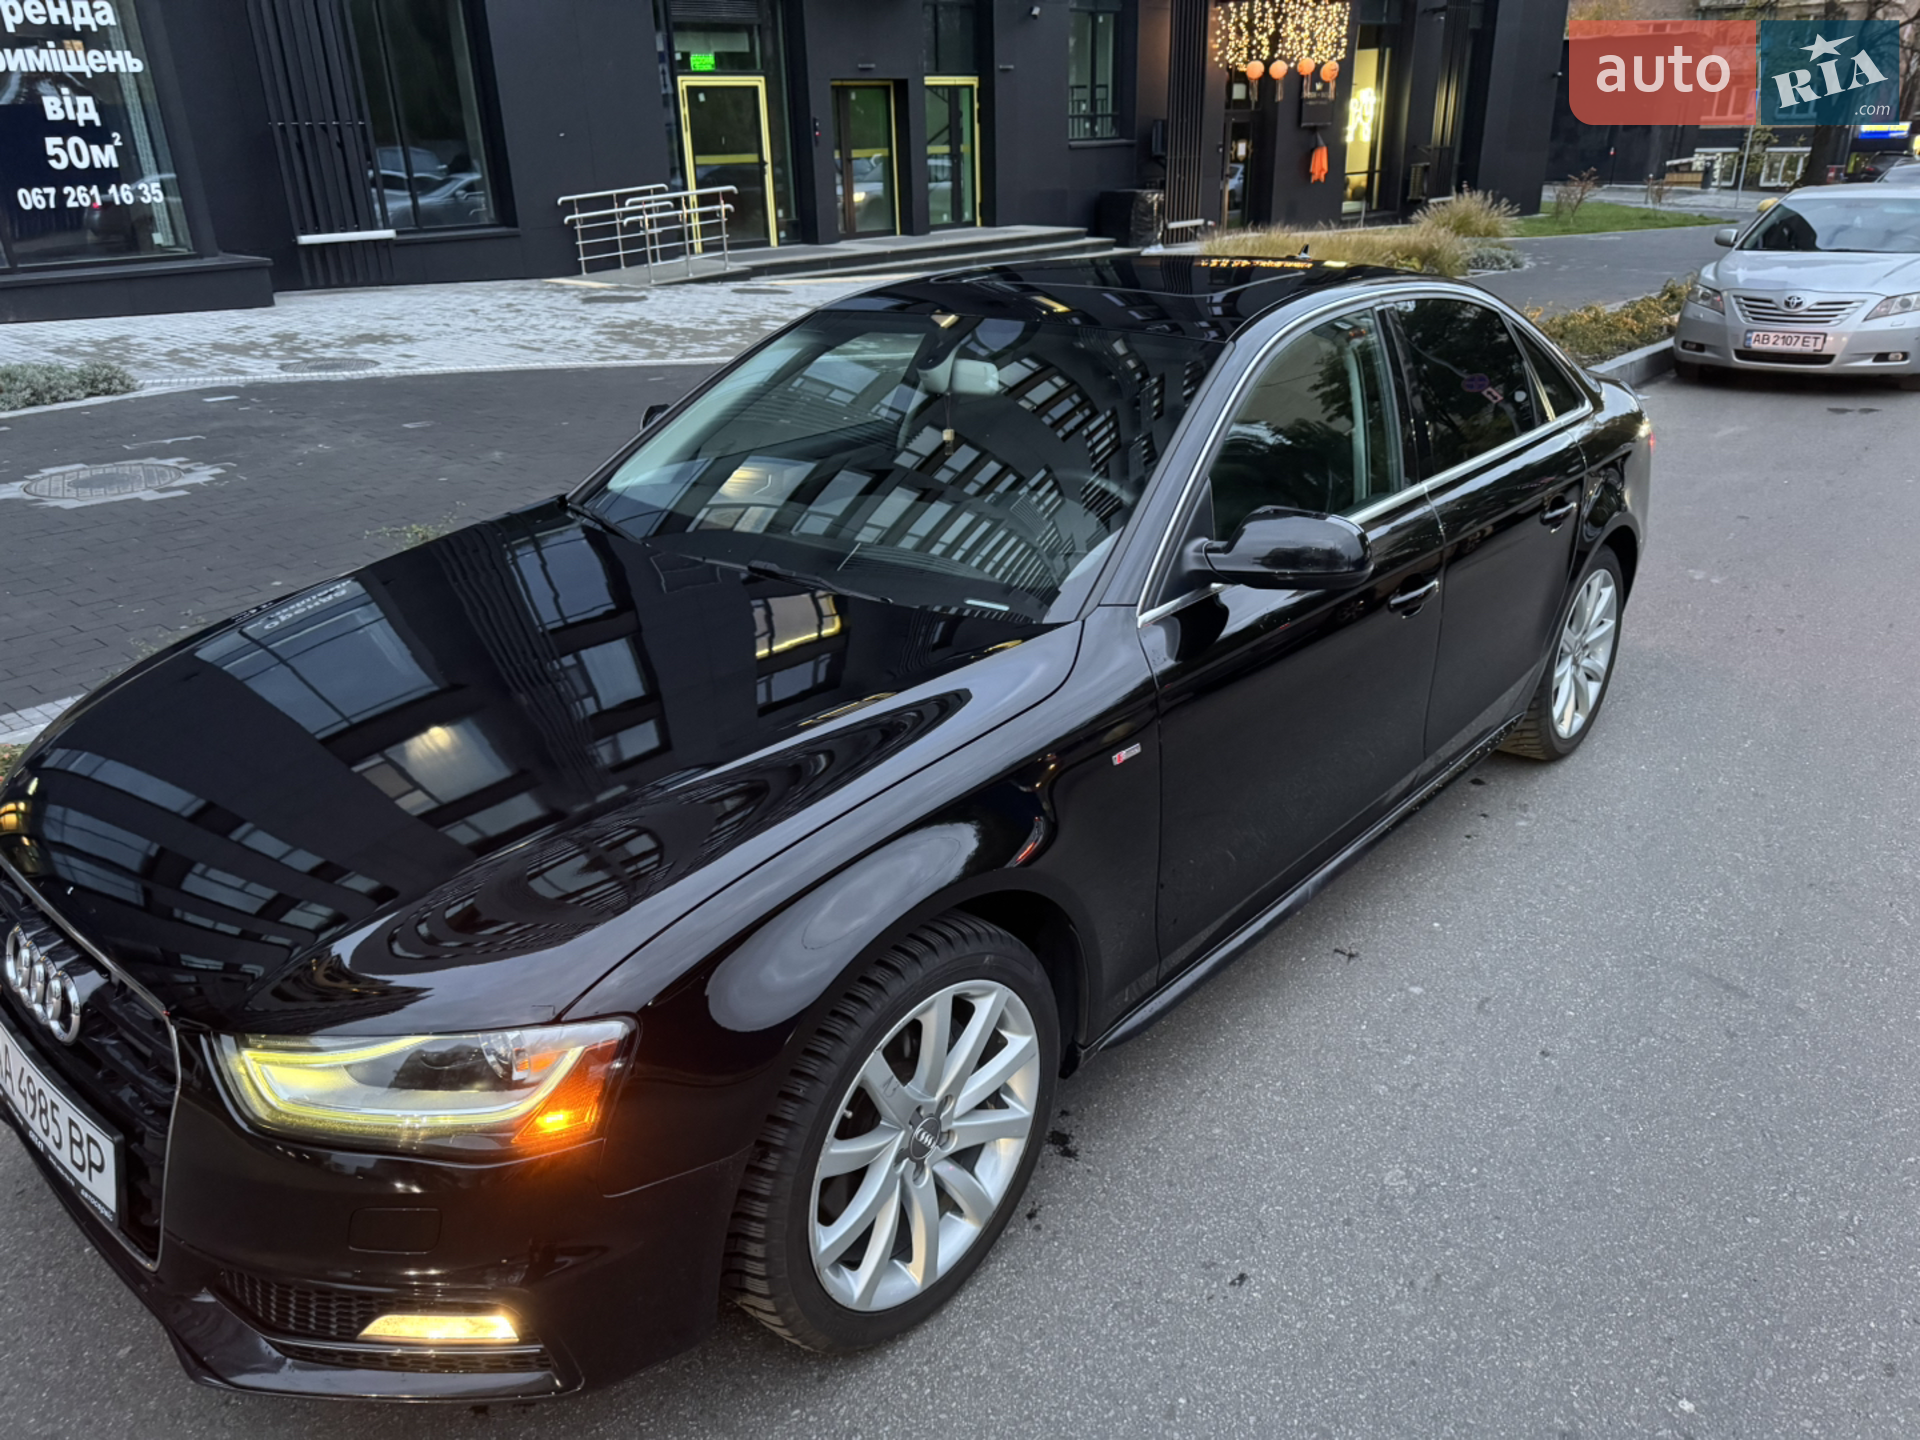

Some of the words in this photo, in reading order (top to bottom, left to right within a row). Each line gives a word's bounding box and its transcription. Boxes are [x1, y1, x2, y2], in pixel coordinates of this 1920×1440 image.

[0, 0, 117, 32] ренда
[42, 87, 102, 127] від
[17, 186, 56, 210] 067
[63, 184, 102, 208] 261
[108, 183, 134, 205] 16
[138, 182, 164, 203] 35
[1752, 333, 1770, 345] AB
[1772, 334, 1800, 347] 2107
[1801, 335, 1821, 348] ET
[18, 1066, 62, 1151] 4985
[67, 1116, 105, 1183] BP
